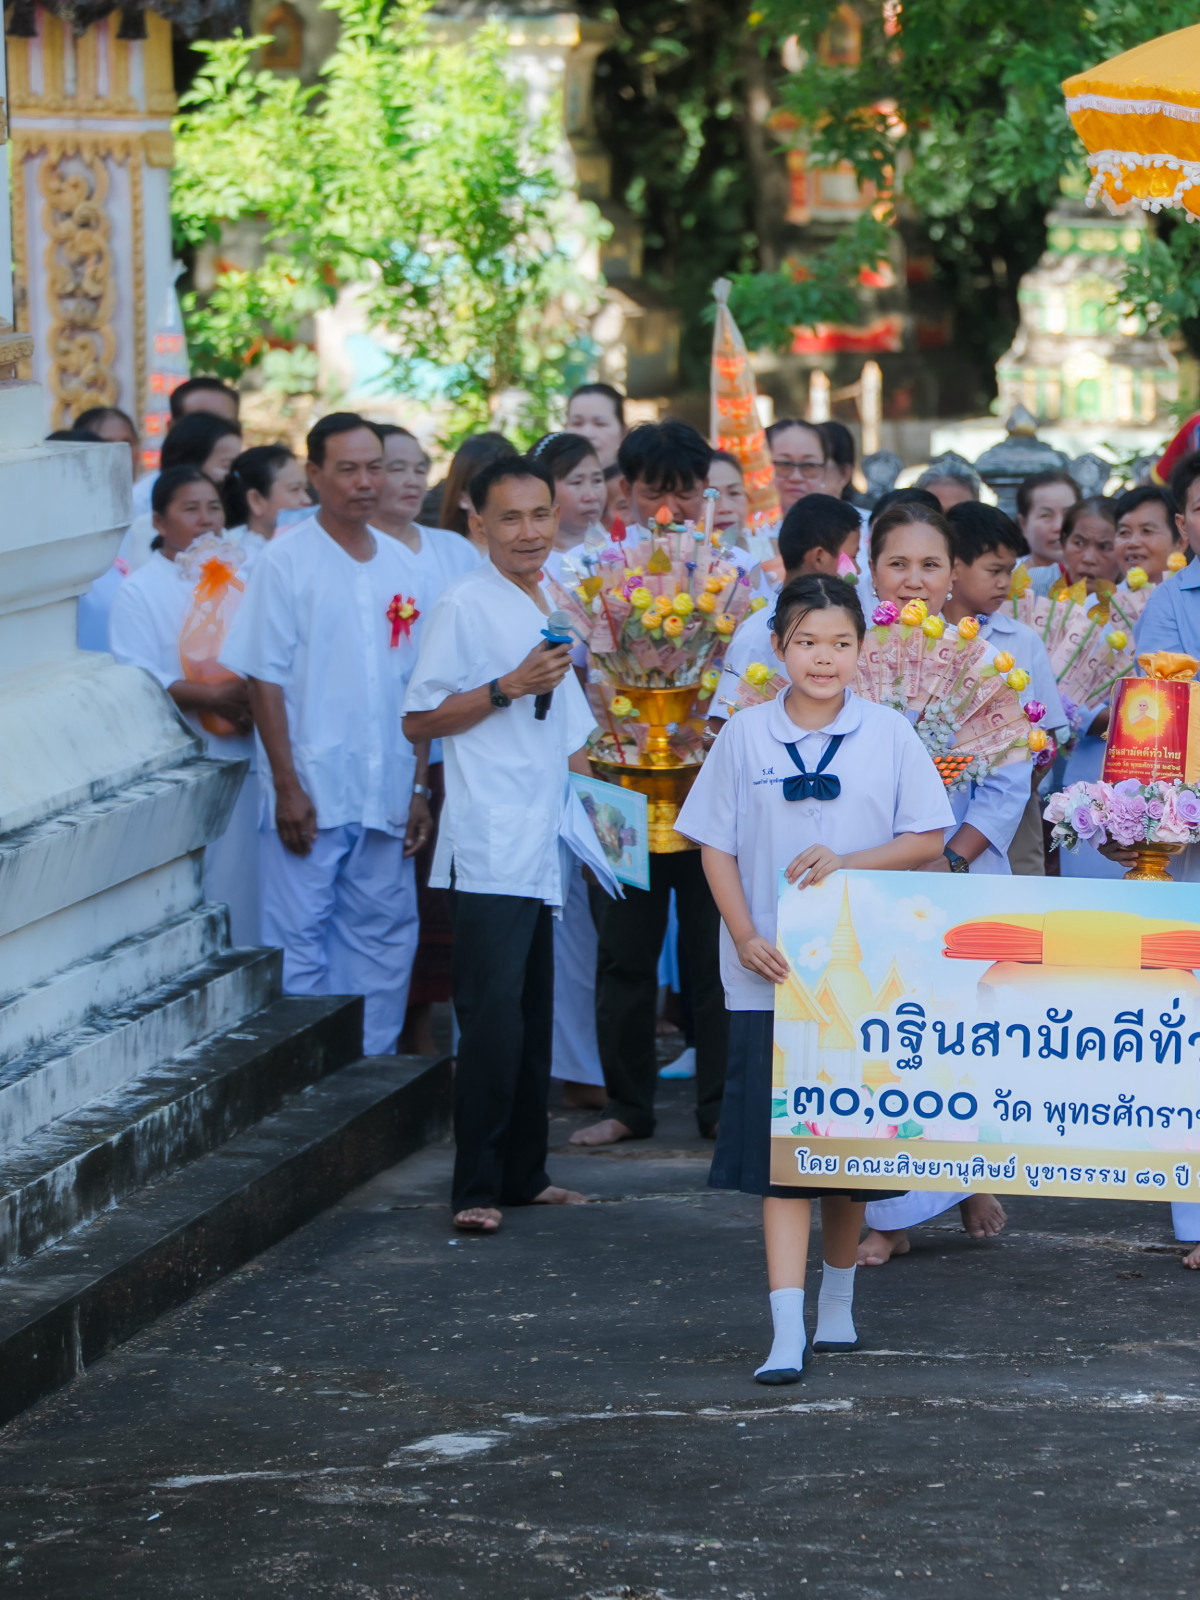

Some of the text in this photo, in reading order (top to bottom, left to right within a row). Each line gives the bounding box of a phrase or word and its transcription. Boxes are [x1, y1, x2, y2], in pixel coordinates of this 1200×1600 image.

[793, 1085, 978, 1125] ๓๐,๐๐๐
[993, 1088, 1032, 1123] วัด
[797, 1150, 838, 1173] โดย
[847, 1154, 1017, 1184] คณะศิษยานุศิษย์
[1025, 1165, 1126, 1187] บูชาธรรม
[1136, 1169, 1166, 1187] ๘๑
[1176, 1165, 1190, 1187] ปี
